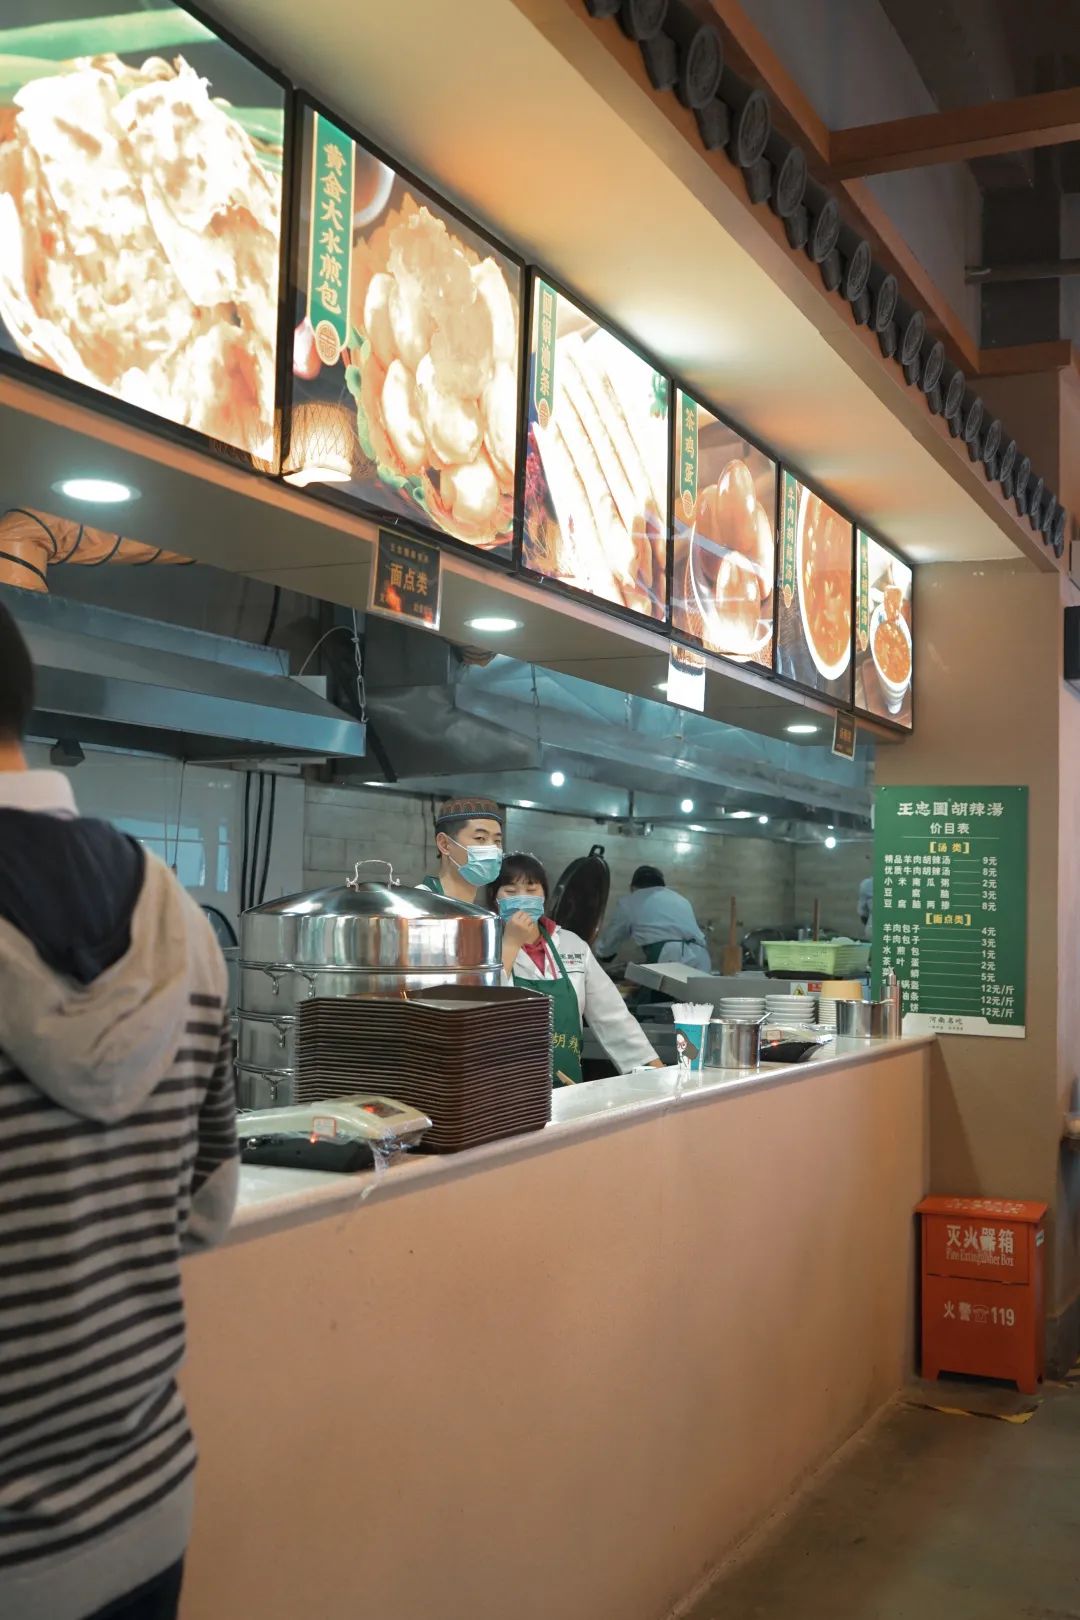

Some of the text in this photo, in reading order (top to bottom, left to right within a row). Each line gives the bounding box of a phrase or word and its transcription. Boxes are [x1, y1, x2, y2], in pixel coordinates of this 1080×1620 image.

[315, 143, 347, 315] 黄金大水煎包
[930, 822, 970, 834] 价目表
[884, 854, 998, 866] 精品羊肉胡辣汤 9元
[884, 865, 997, 878] 优质牛肉胡辣汤 8元
[982, 879, 997, 889] 2元
[982, 891, 997, 900] 3元
[982, 902, 997, 912] 8元
[883, 923, 996, 937] 羊肉包子 4元
[883, 934, 996, 948] 牛肉包子 3元
[882, 946, 996, 959] 水煎包 1元
[882, 957, 996, 971] 茶叶蛋 2元
[981, 972, 996, 982] 5元
[981, 984, 1015, 995] 12元/斤
[981, 996, 1014, 1007] 12元/斤
[980, 1007, 1014, 1018] 12元/斤
[946, 1224, 1014, 1253] 灭火器箱
[1001, 1254, 1014, 1266] Box
[944, 1300, 1015, 1326] 火警 119
